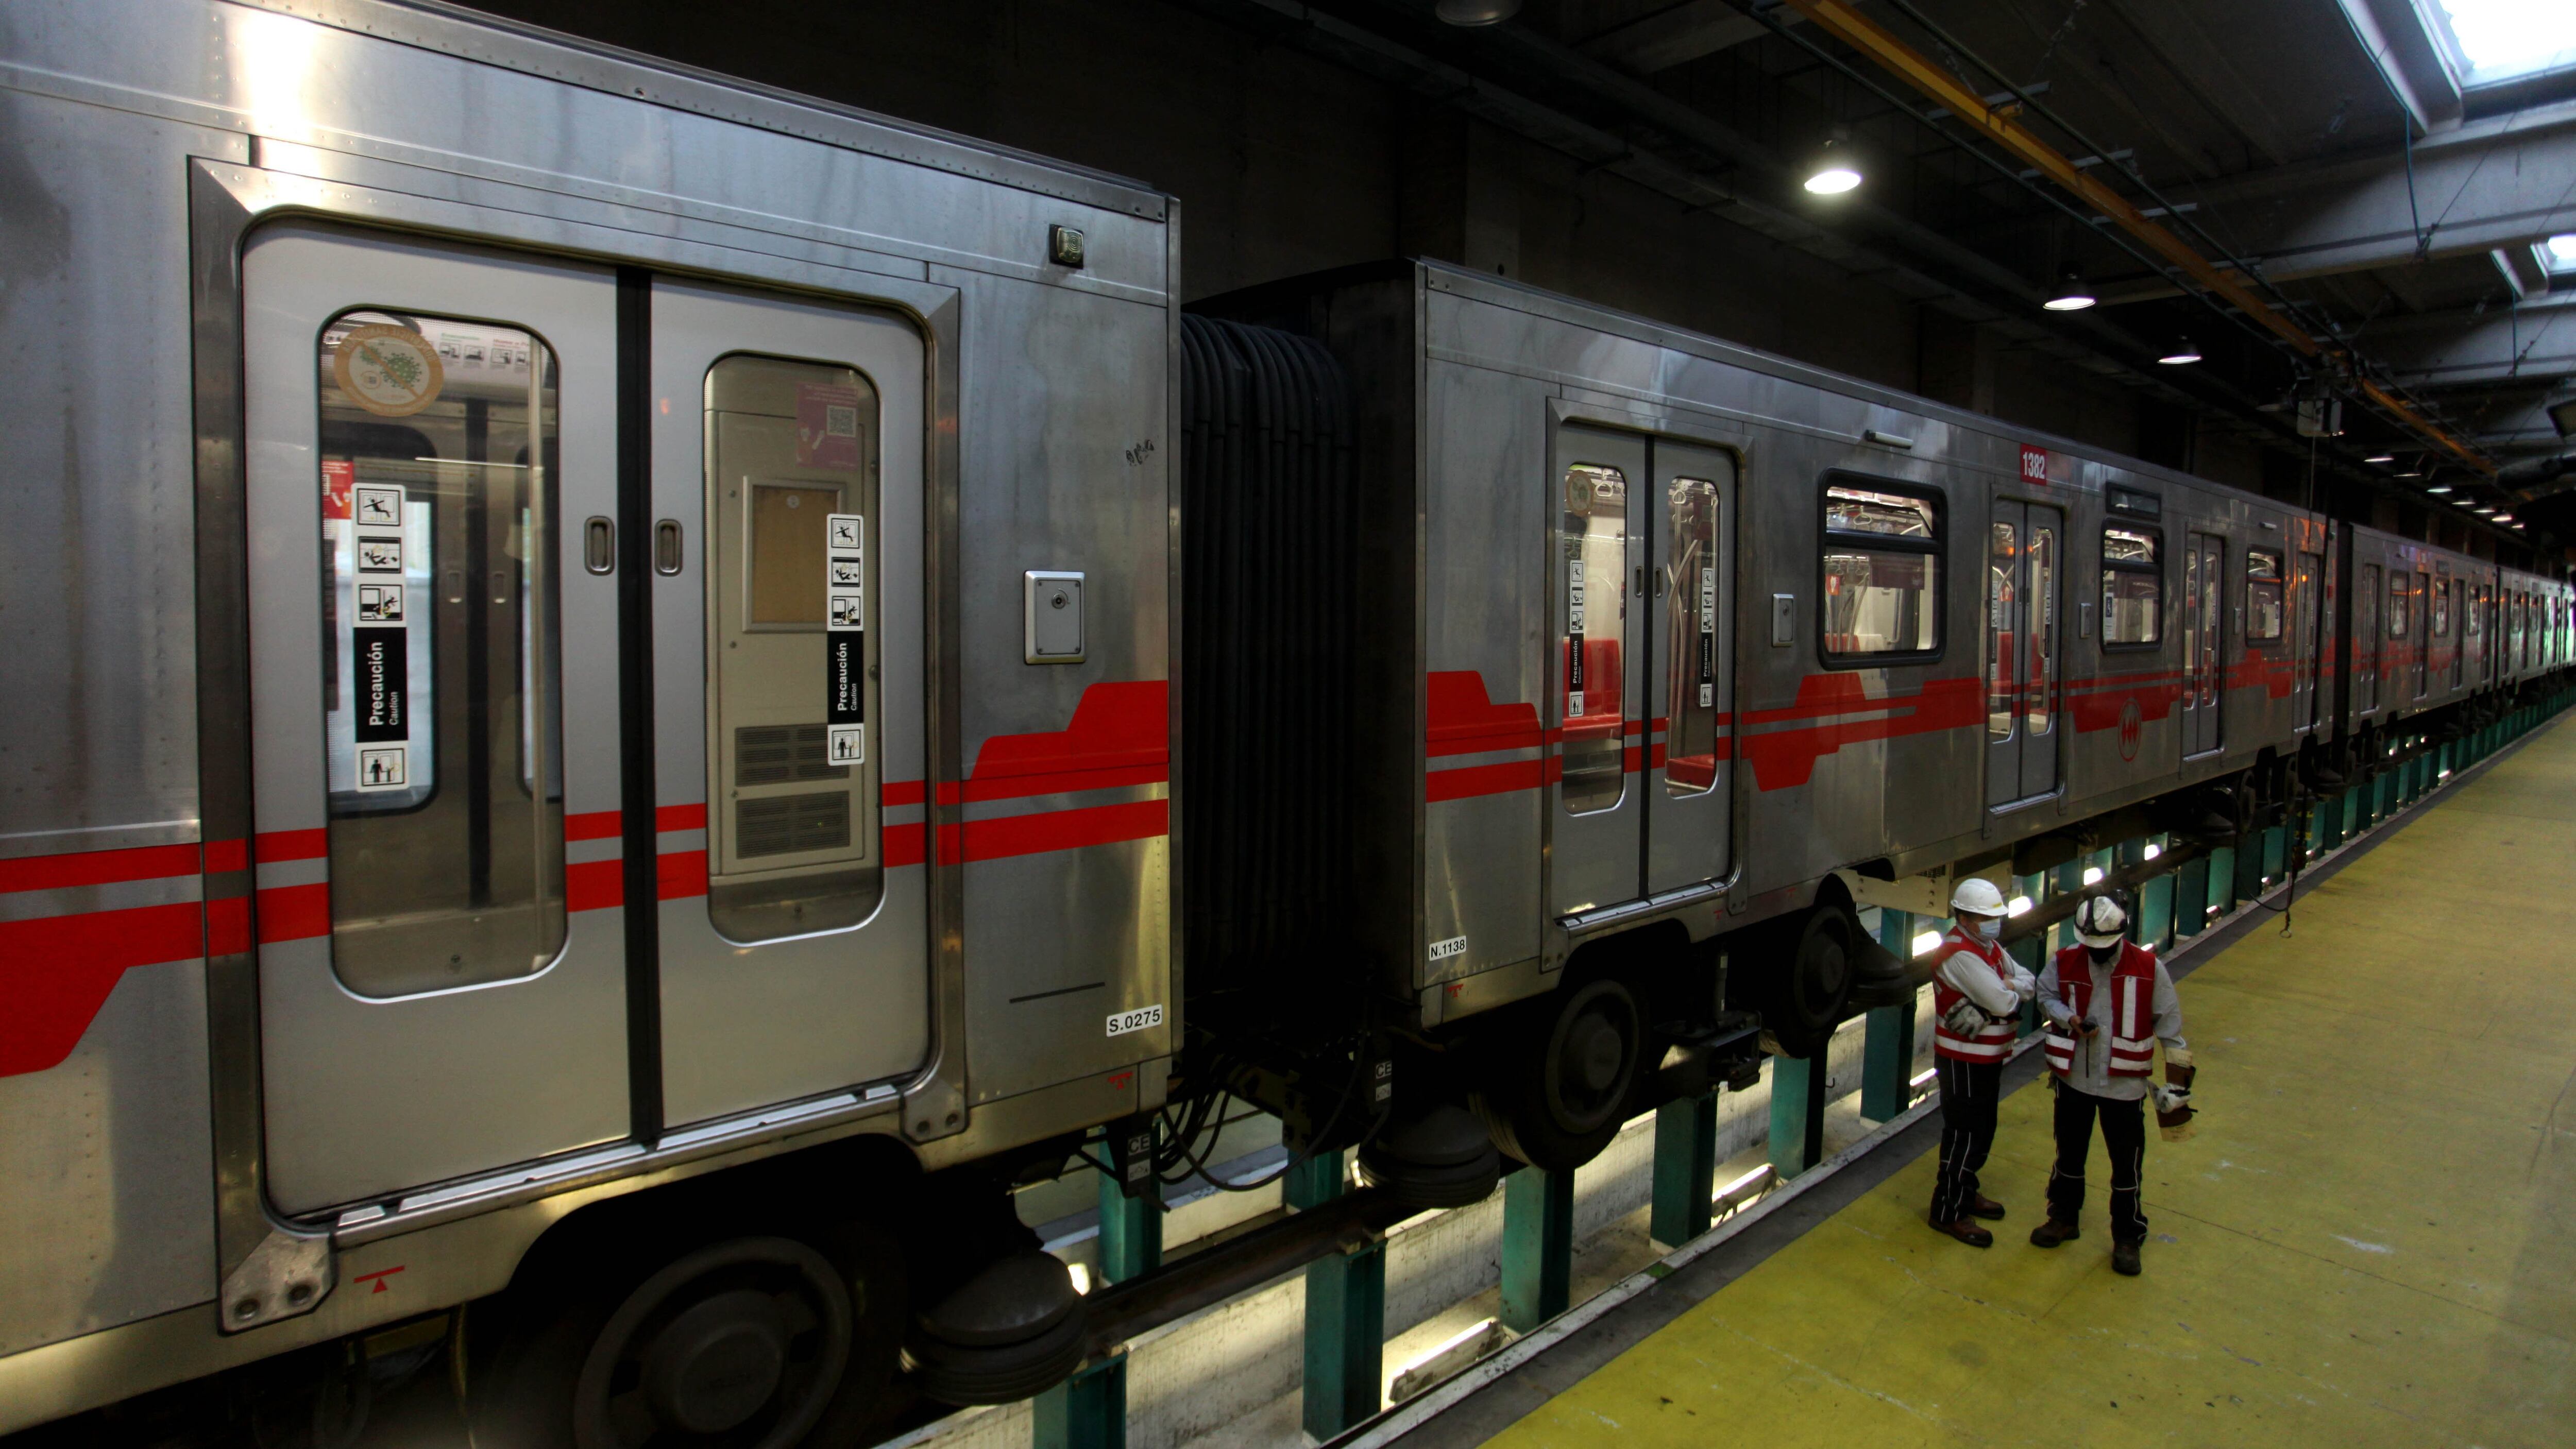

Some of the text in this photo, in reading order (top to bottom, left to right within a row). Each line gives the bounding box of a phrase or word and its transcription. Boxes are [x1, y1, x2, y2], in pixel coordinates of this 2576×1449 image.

[2023, 451, 2045, 480] 1382
[367, 641, 384, 726] Precaución
[836, 642, 848, 711] Precaución
[389, 691, 400, 726] Caution
[1431, 939, 1465, 958] N.1138
[1109, 1008, 1160, 1032] S.0275
